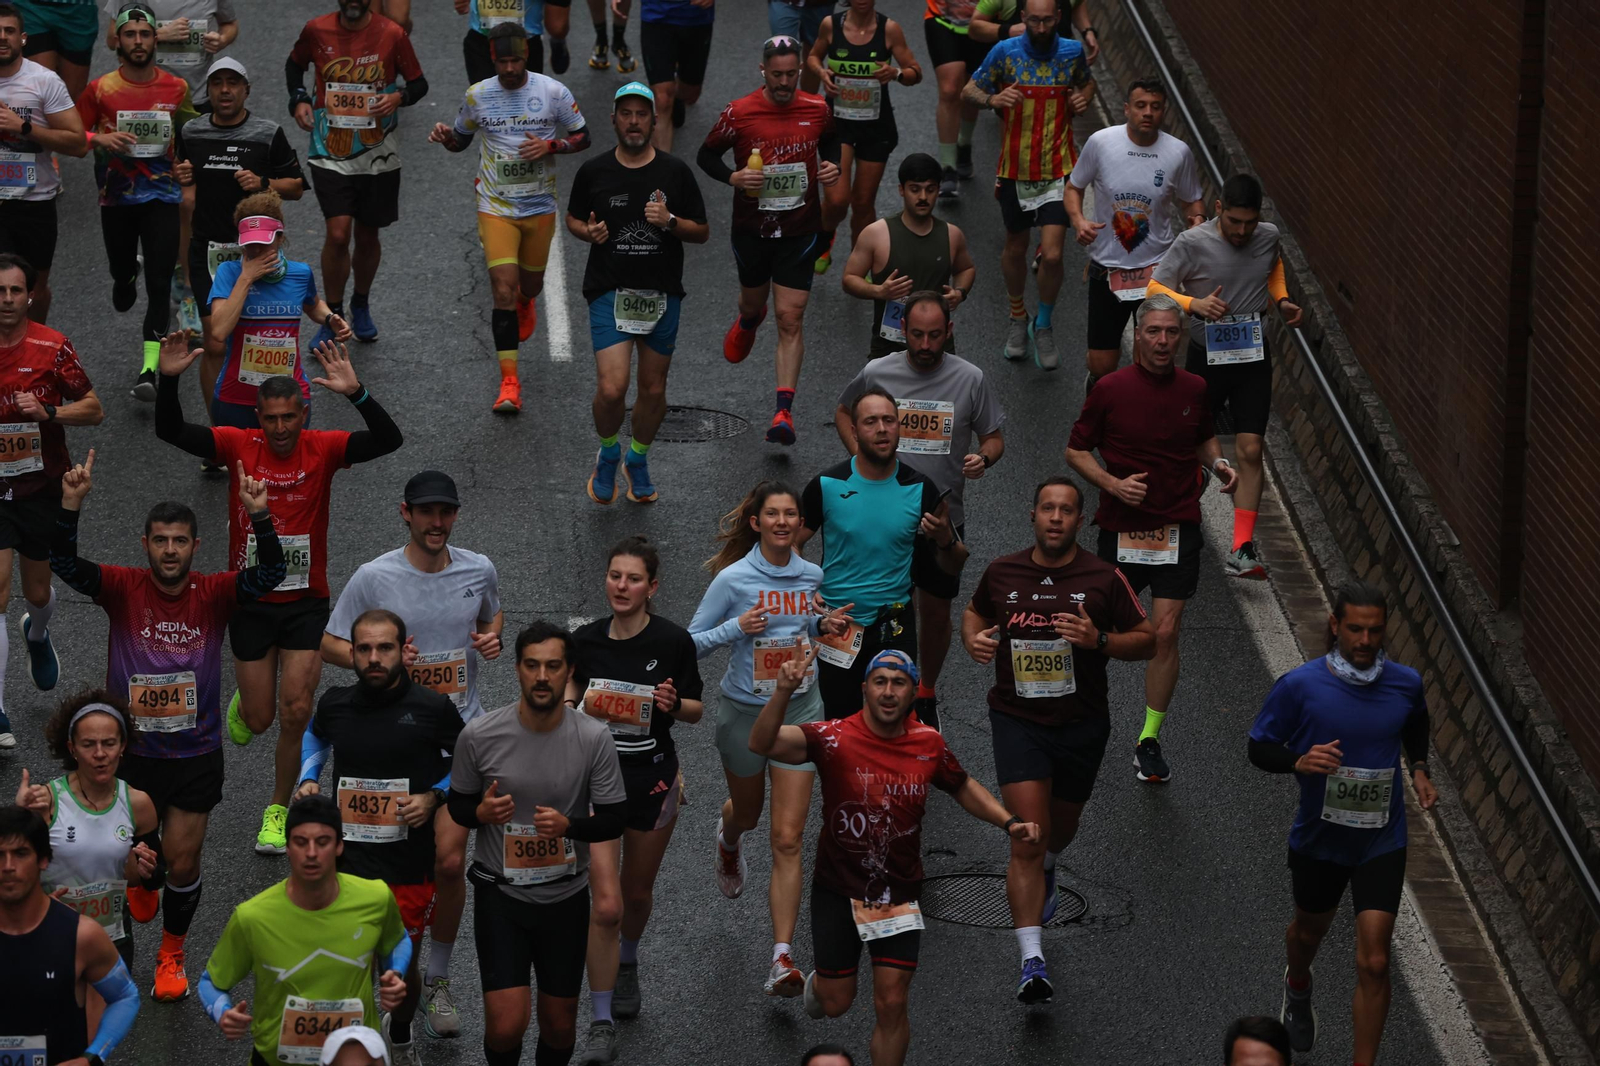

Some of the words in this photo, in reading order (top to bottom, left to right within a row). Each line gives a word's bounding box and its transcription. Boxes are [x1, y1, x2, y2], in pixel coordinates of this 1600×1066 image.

[356, 54, 379, 66] FRESH
[321, 56, 386, 84] Beer
[838, 63, 870, 75] ASM
[333, 94, 364, 109] 3843
[841, 88, 870, 102] 6940
[126, 122, 159, 137] 7694
[482, 116, 506, 127] Falcón
[510, 116, 548, 128] Training
[1128, 151, 1158, 159] GIVOVA
[503, 162, 534, 177] 6654
[765, 175, 796, 190] 7627
[1120, 268, 1145, 282] 902
[246, 304, 302, 316] CREDUS
[623, 297, 656, 314] 9400
[1214, 326, 1248, 342] 2891
[247, 348, 289, 366] 12008
[900, 413, 939, 431] 4905
[0, 436, 26, 452] 610
[1016, 654, 1064, 672] 12598
[412, 666, 452, 686] 6250
[138, 688, 180, 708] 4994
[593, 694, 636, 716] 4764
[874, 772, 924, 784] MEDIO
[1337, 782, 1379, 802] 9465
[348, 794, 392, 814] 4837
[838, 809, 867, 838] 30
[514, 838, 558, 858] 3688
[294, 1016, 344, 1036] 6344
